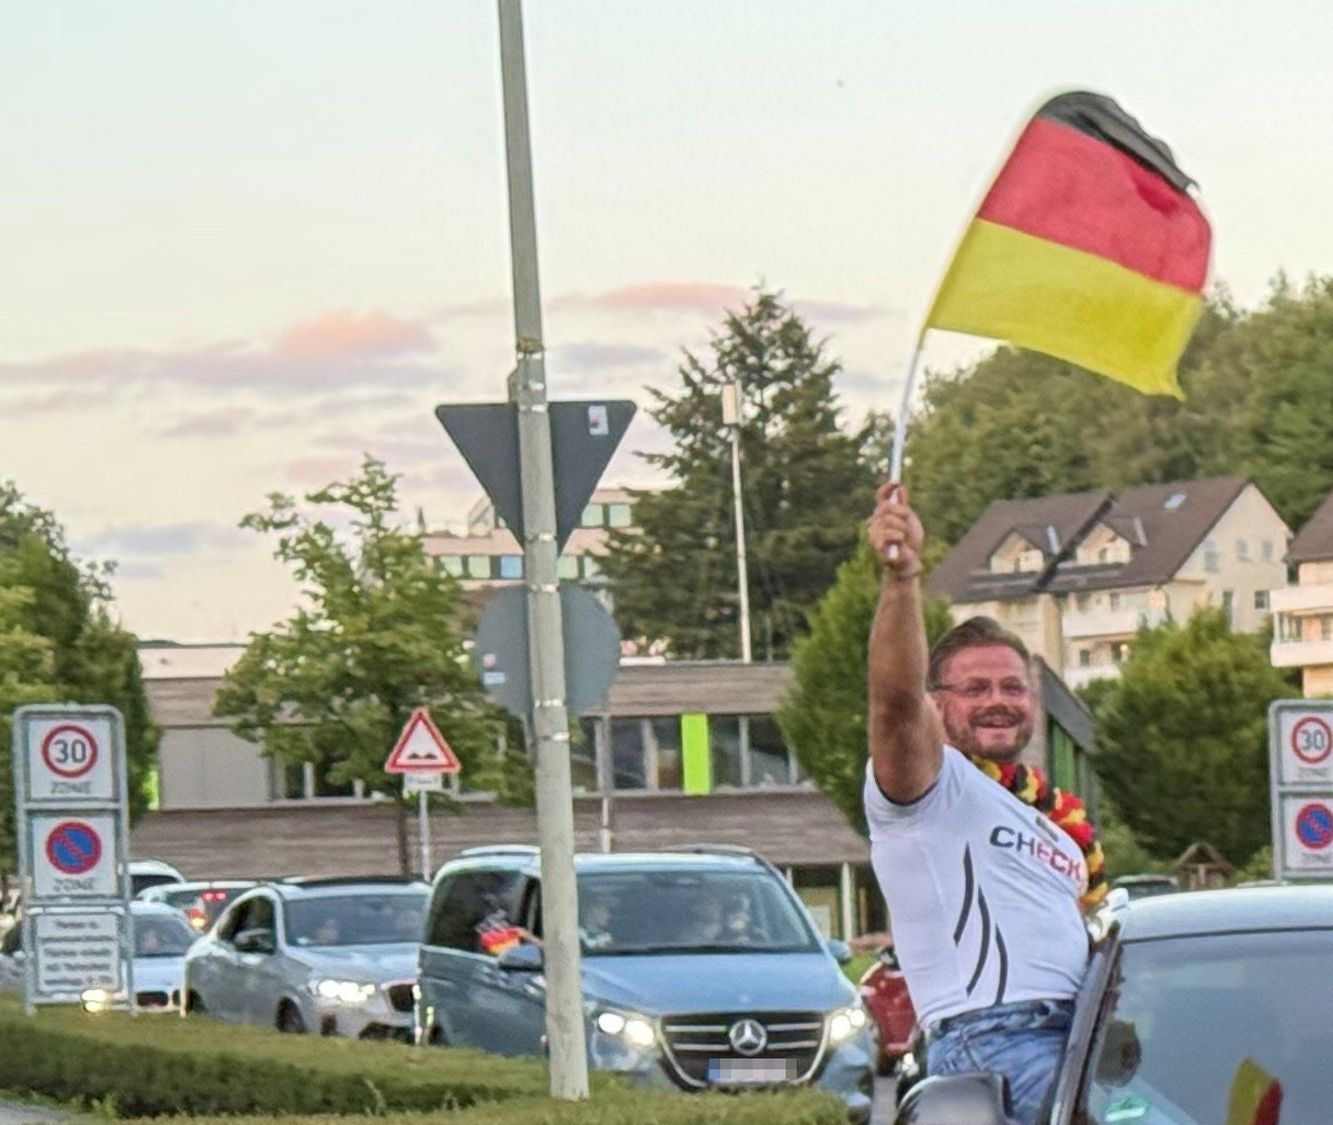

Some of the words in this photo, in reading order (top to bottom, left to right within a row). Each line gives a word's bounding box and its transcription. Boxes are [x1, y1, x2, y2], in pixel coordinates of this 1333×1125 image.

[53, 738, 87, 763] 30
[1301, 729, 1325, 751] 30
[989, 825, 1081, 883] CHECK
